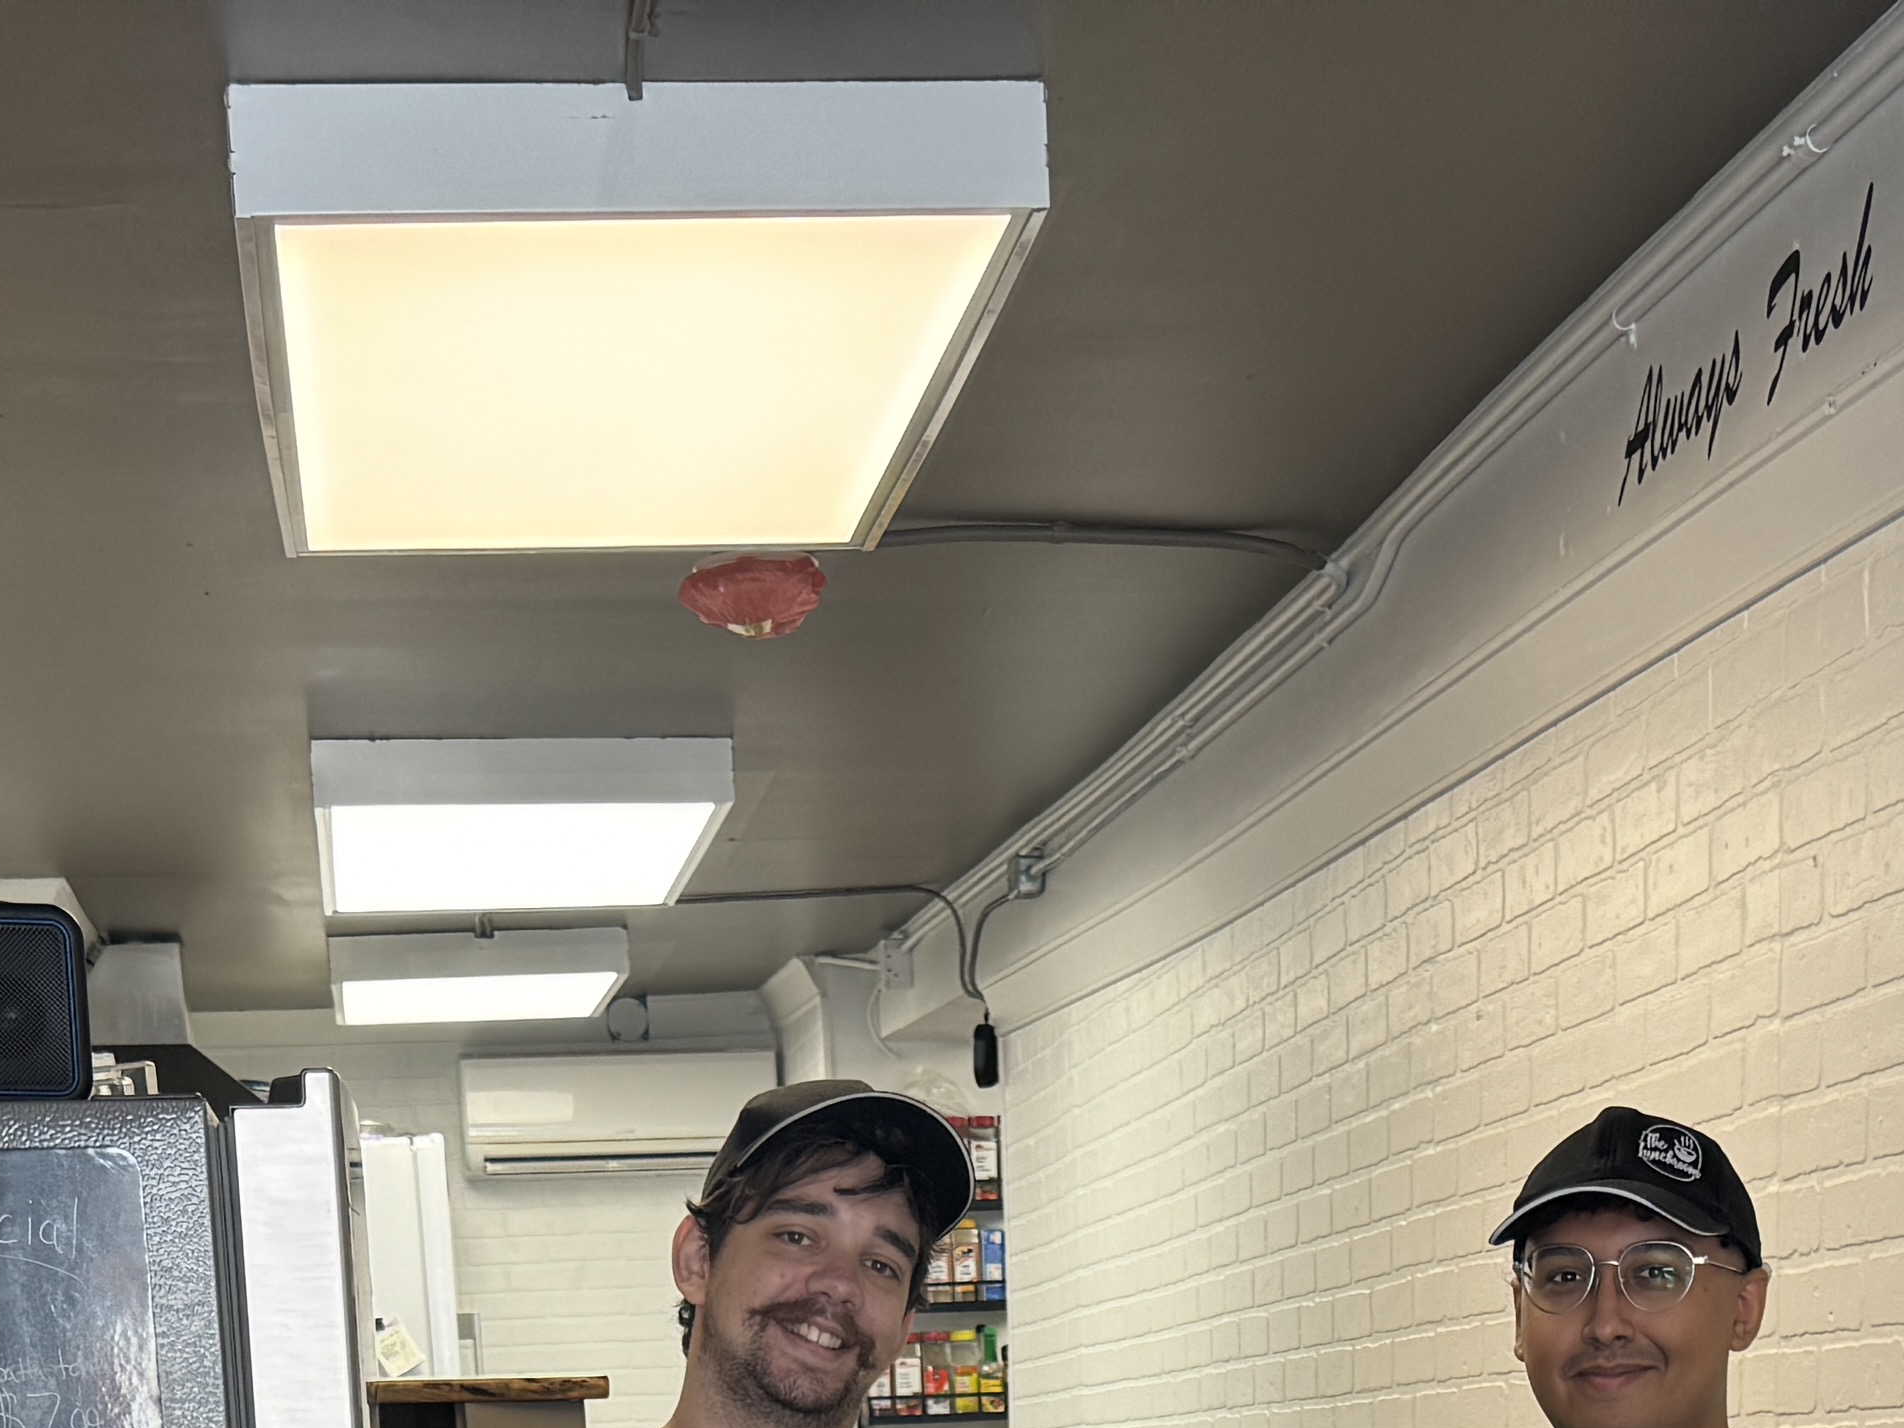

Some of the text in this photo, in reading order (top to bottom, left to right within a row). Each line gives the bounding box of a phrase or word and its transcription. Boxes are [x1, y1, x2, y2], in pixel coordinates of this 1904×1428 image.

[1618, 181, 1874, 507] Always Fresh
[1642, 1131, 1669, 1150] The
